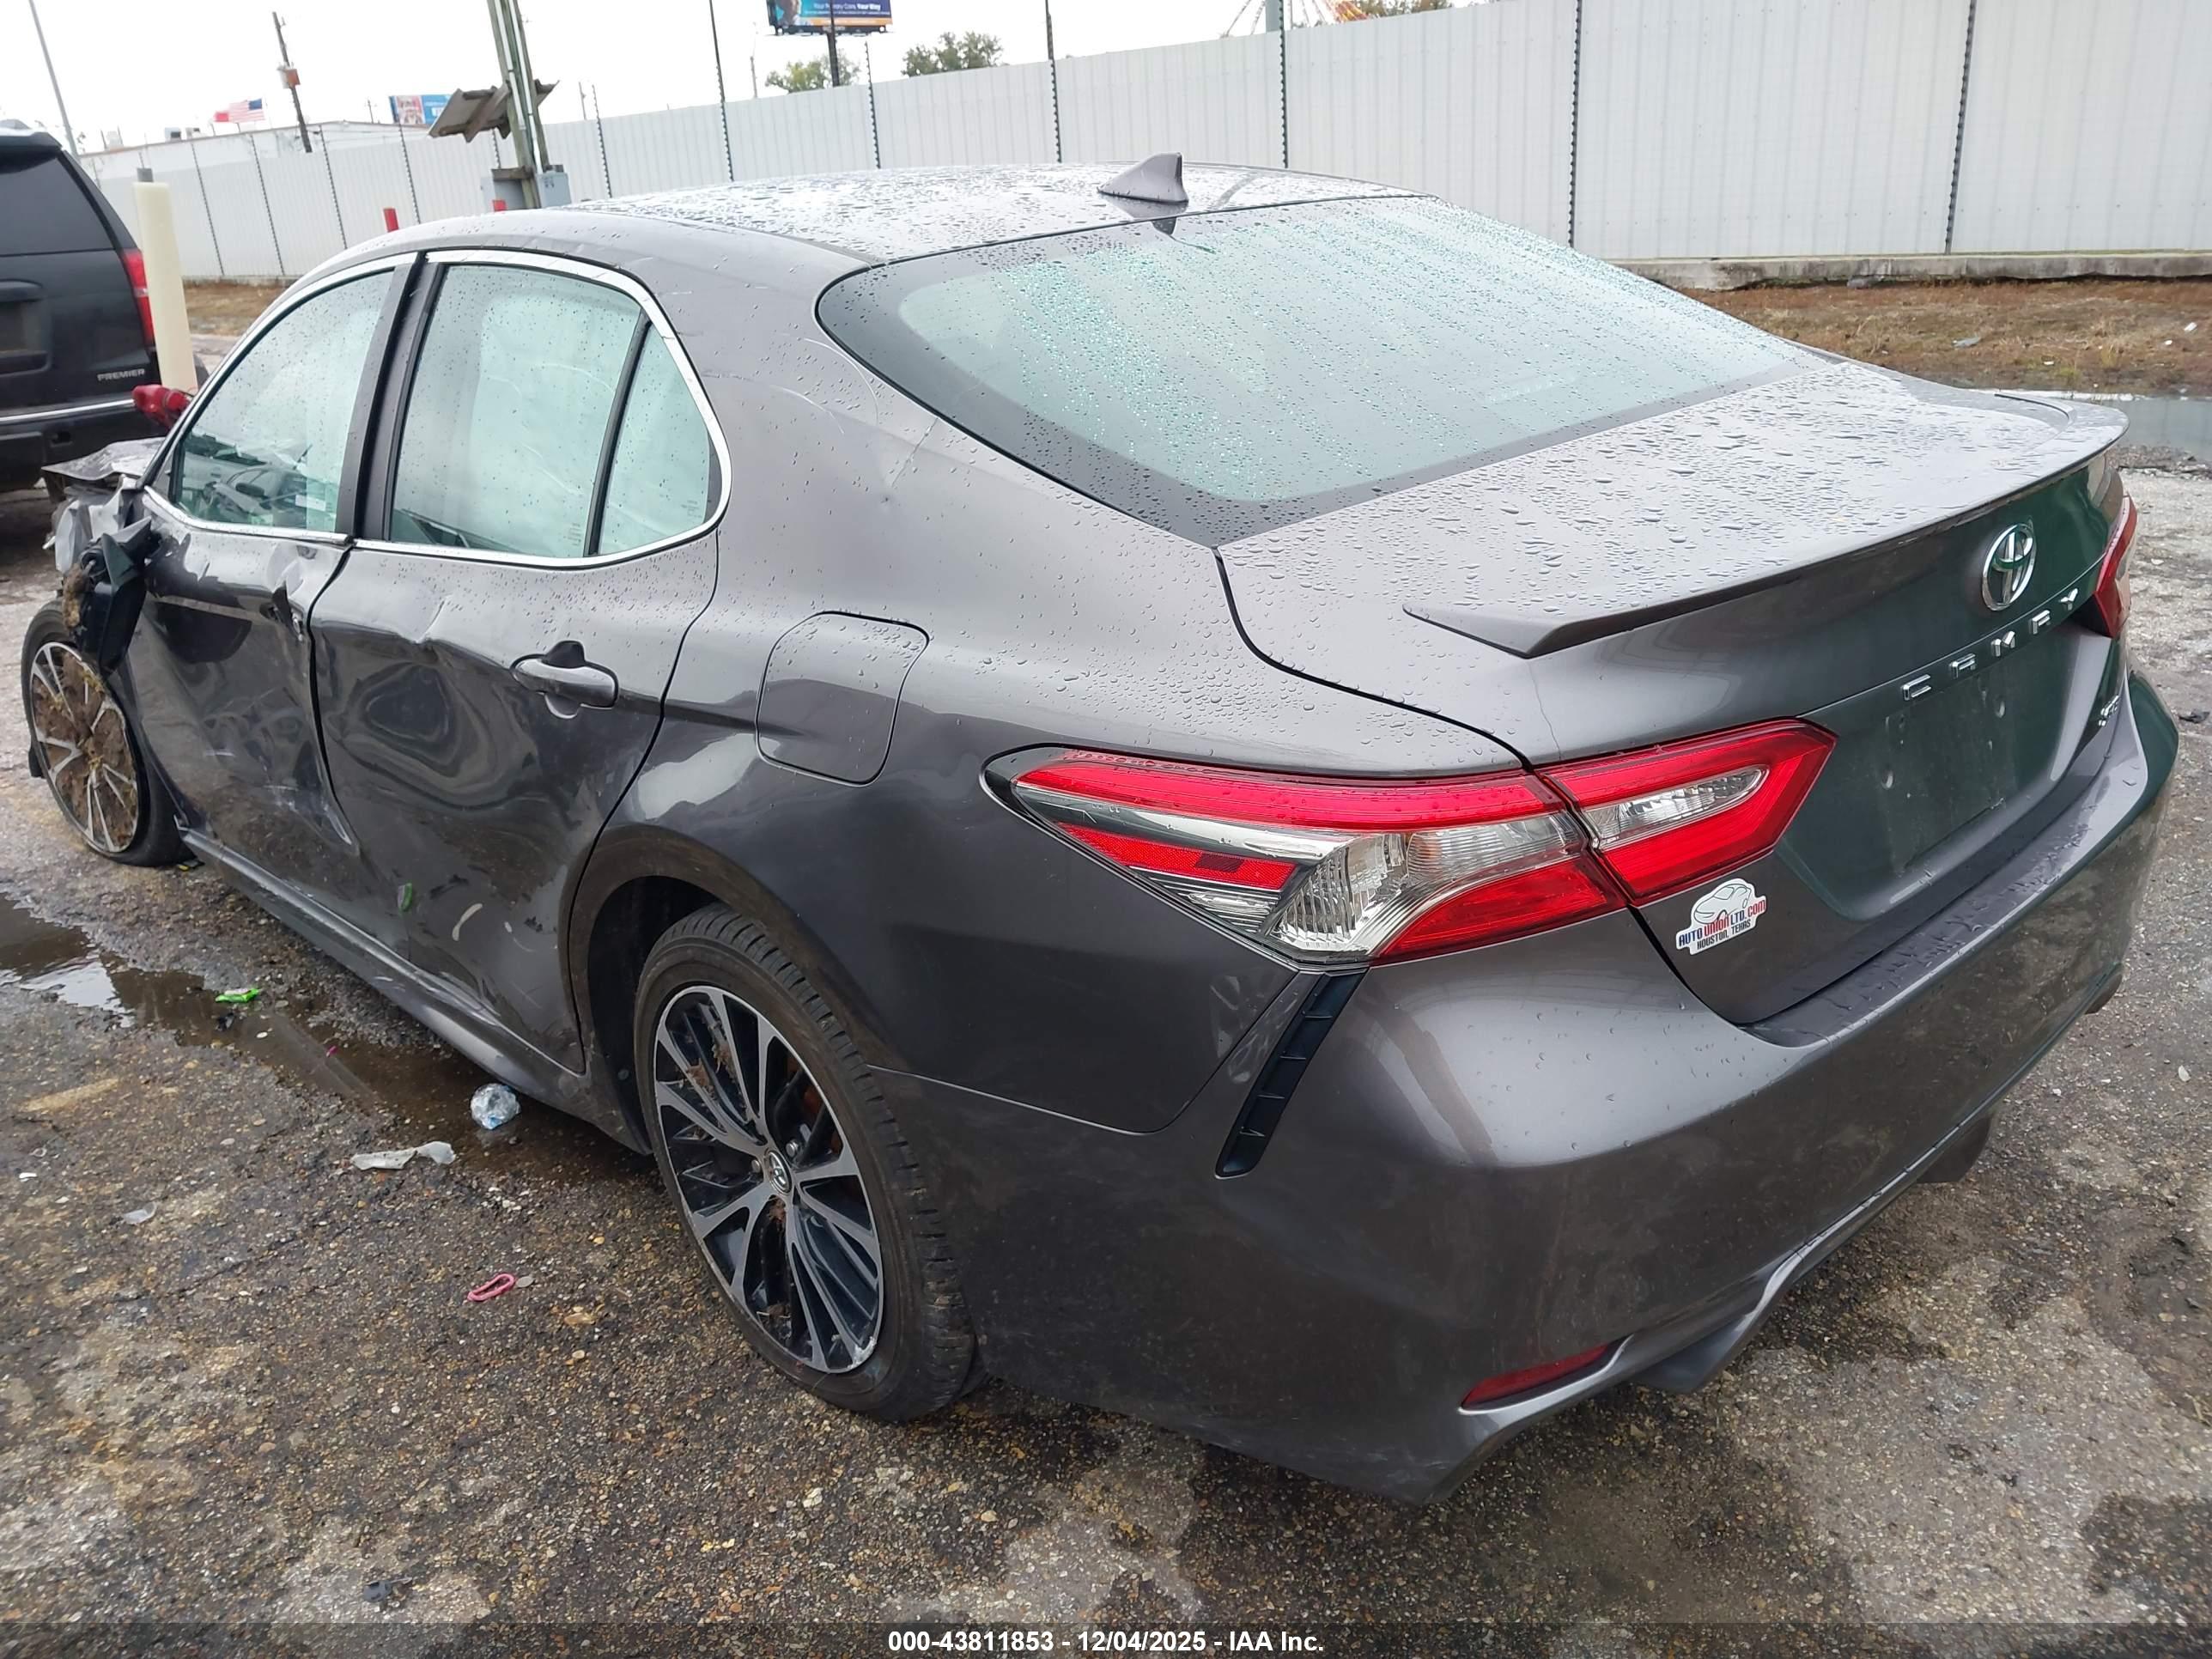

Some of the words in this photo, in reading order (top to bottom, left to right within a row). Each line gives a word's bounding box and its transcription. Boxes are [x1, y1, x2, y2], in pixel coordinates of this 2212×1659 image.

[97, 368, 145, 381] PREMIER
[1900, 587, 2079, 702] CAMRY
[1679, 927, 1703, 947] AUTO
[1704, 915, 1729, 936] UNION
[1697, 930, 1729, 950] HOUSTON,
[1731, 919, 1751, 935] TEXAS
